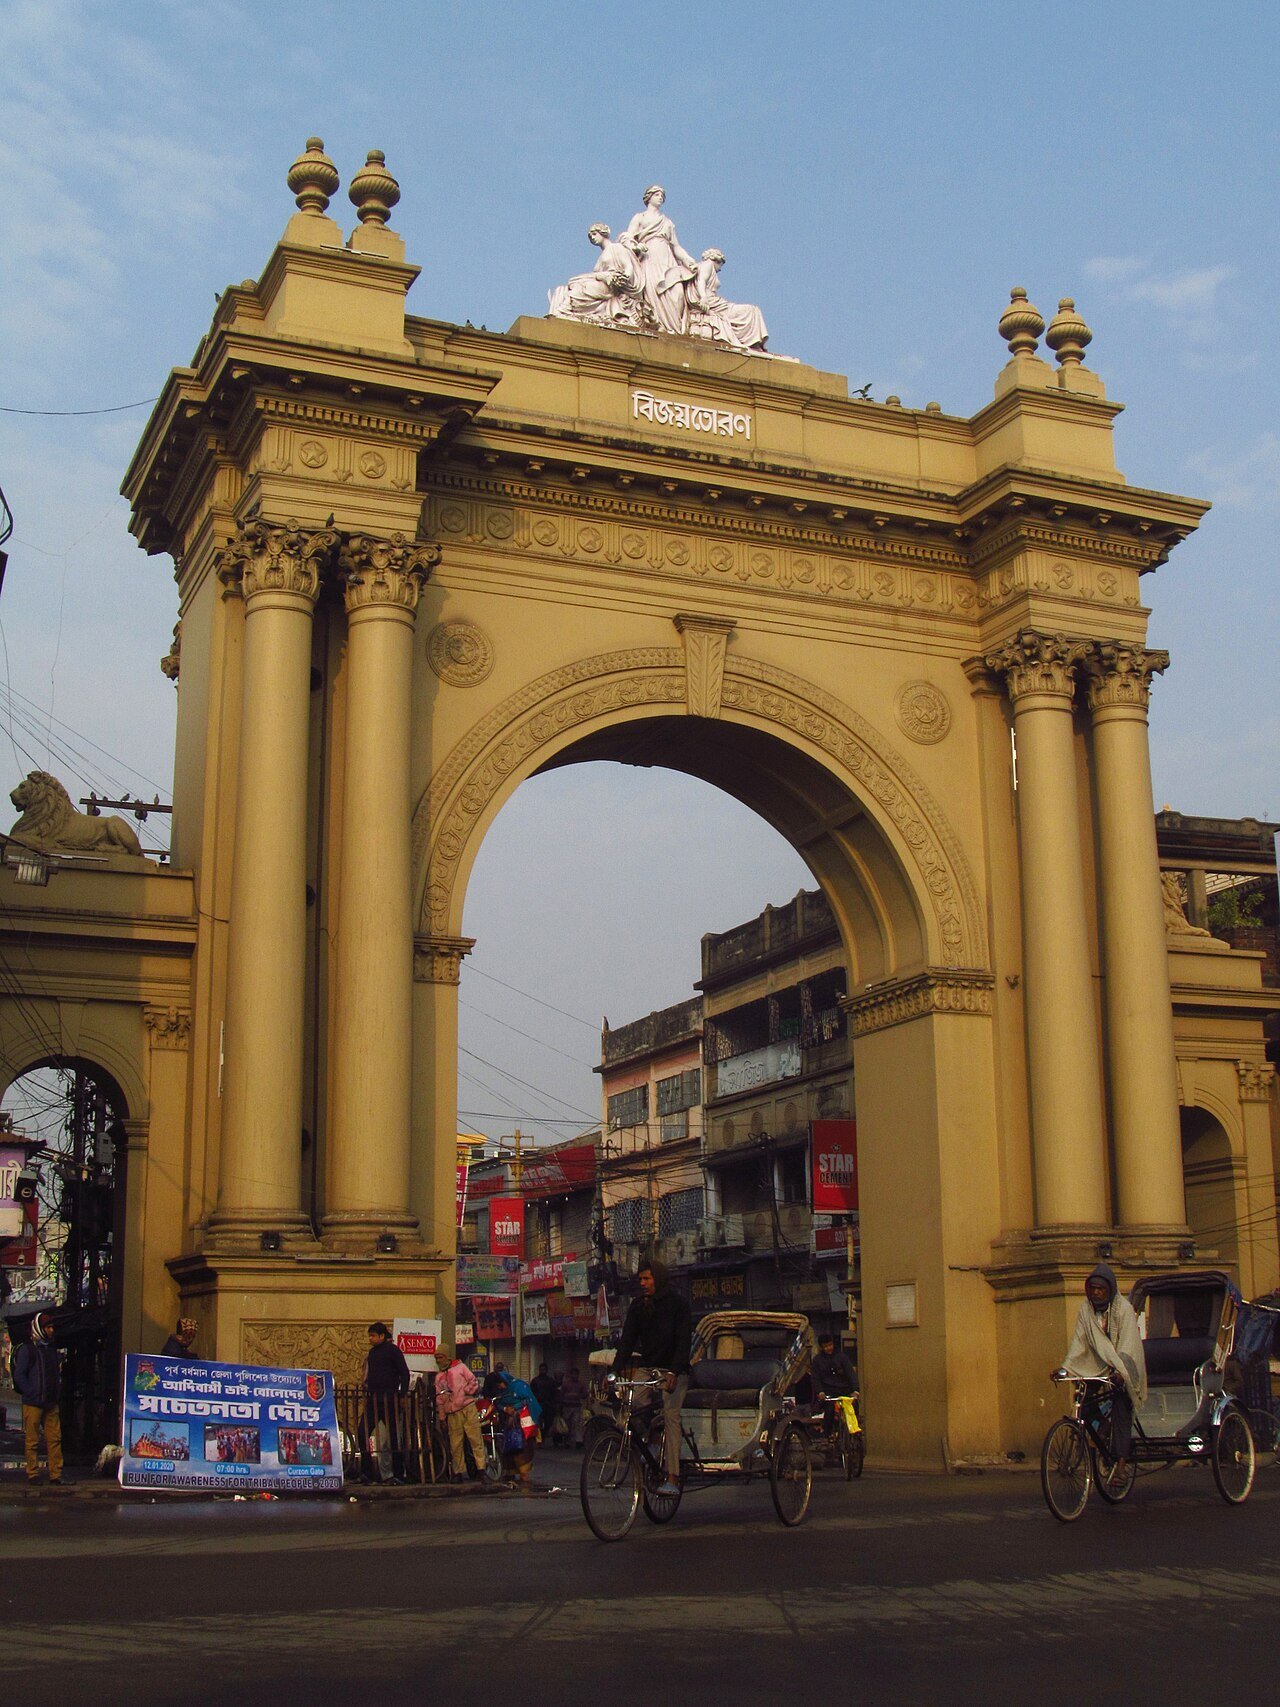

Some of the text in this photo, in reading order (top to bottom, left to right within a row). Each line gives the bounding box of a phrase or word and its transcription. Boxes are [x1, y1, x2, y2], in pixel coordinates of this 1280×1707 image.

[631, 390, 752, 440] বিজয়তোরণ
[819, 1153, 854, 1172] STAR
[819, 1172, 853, 1184] CEMENT
[495, 1221, 520, 1235] STAR
[406, 1338, 434, 1349] SENCO
[164, 1365, 302, 1385] পূর্ব বর্ধমান জেলা পুলিশের উদ্যোগে
[161, 1379, 222, 1394] আদিবাসী
[137, 1394, 321, 1427] সচেতনতা দৌড়
[144, 1461, 174, 1471] 12.01.2020
[235, 1465, 249, 1474] hrs.
[287, 1467, 324, 1476] Curzon Gate
[128, 1472, 148, 1484] RUN
[150, 1474, 170, 1485] FOR
[171, 1475, 225, 1487] AWARENESS
[228, 1477, 246, 1488] FOR
[248, 1477, 279, 1489] TRIBAL
[279, 1478, 313, 1489] PEOPLE
[318, 1478, 339, 1489] 2020
